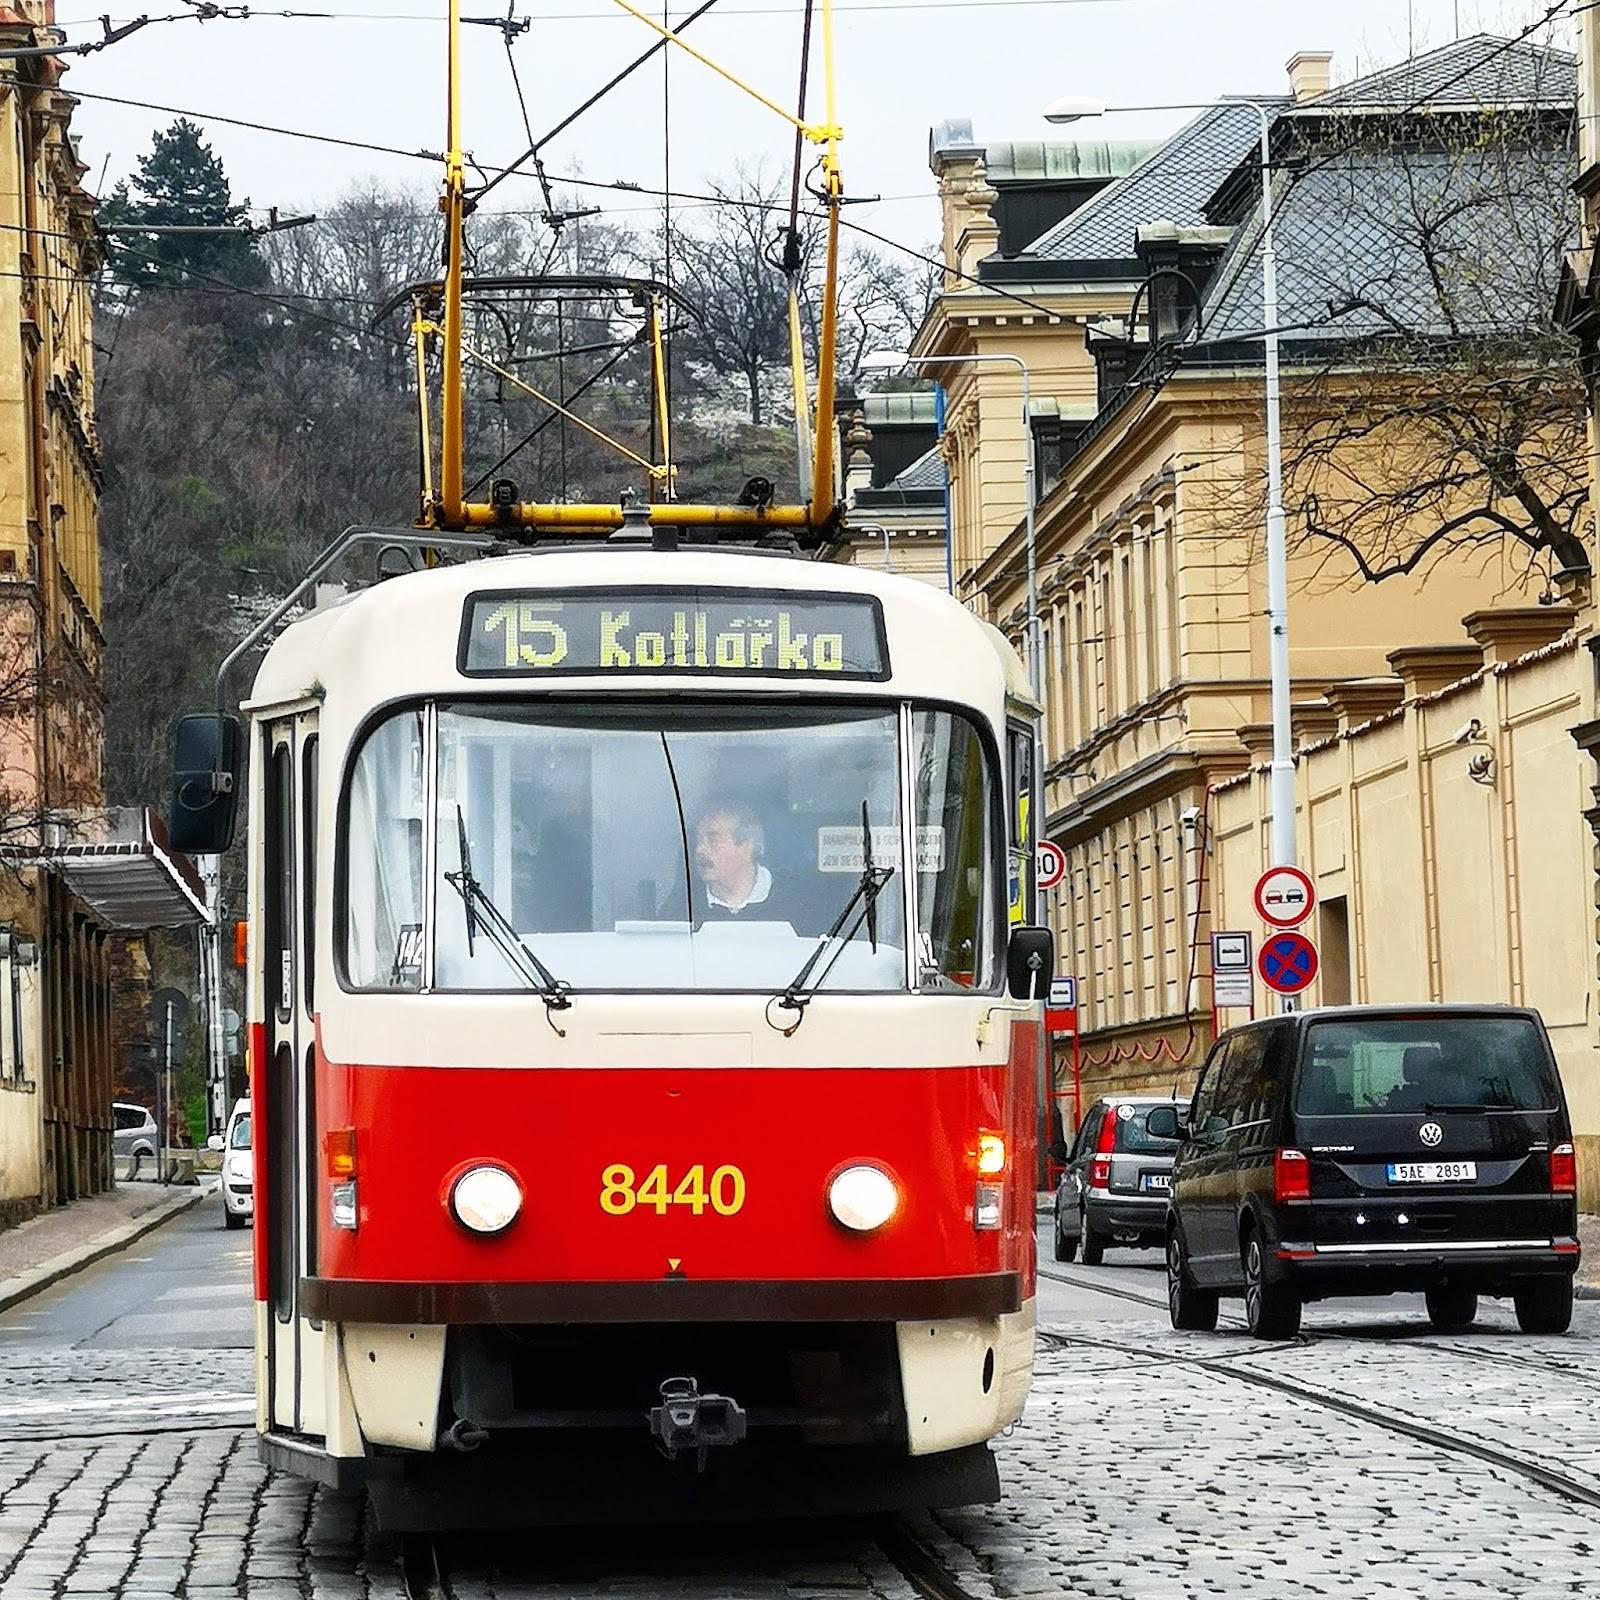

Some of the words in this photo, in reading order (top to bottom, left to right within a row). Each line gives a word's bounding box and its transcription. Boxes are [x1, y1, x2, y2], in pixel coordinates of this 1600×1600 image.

[485, 600, 568, 667] 15
[600, 609, 843, 671] Kotlářka
[1037, 853, 1056, 875] 0
[600, 1163, 746, 1216] 8440
[1399, 1165, 1425, 1179] 5AE
[1435, 1164, 1469, 1178] 2891
